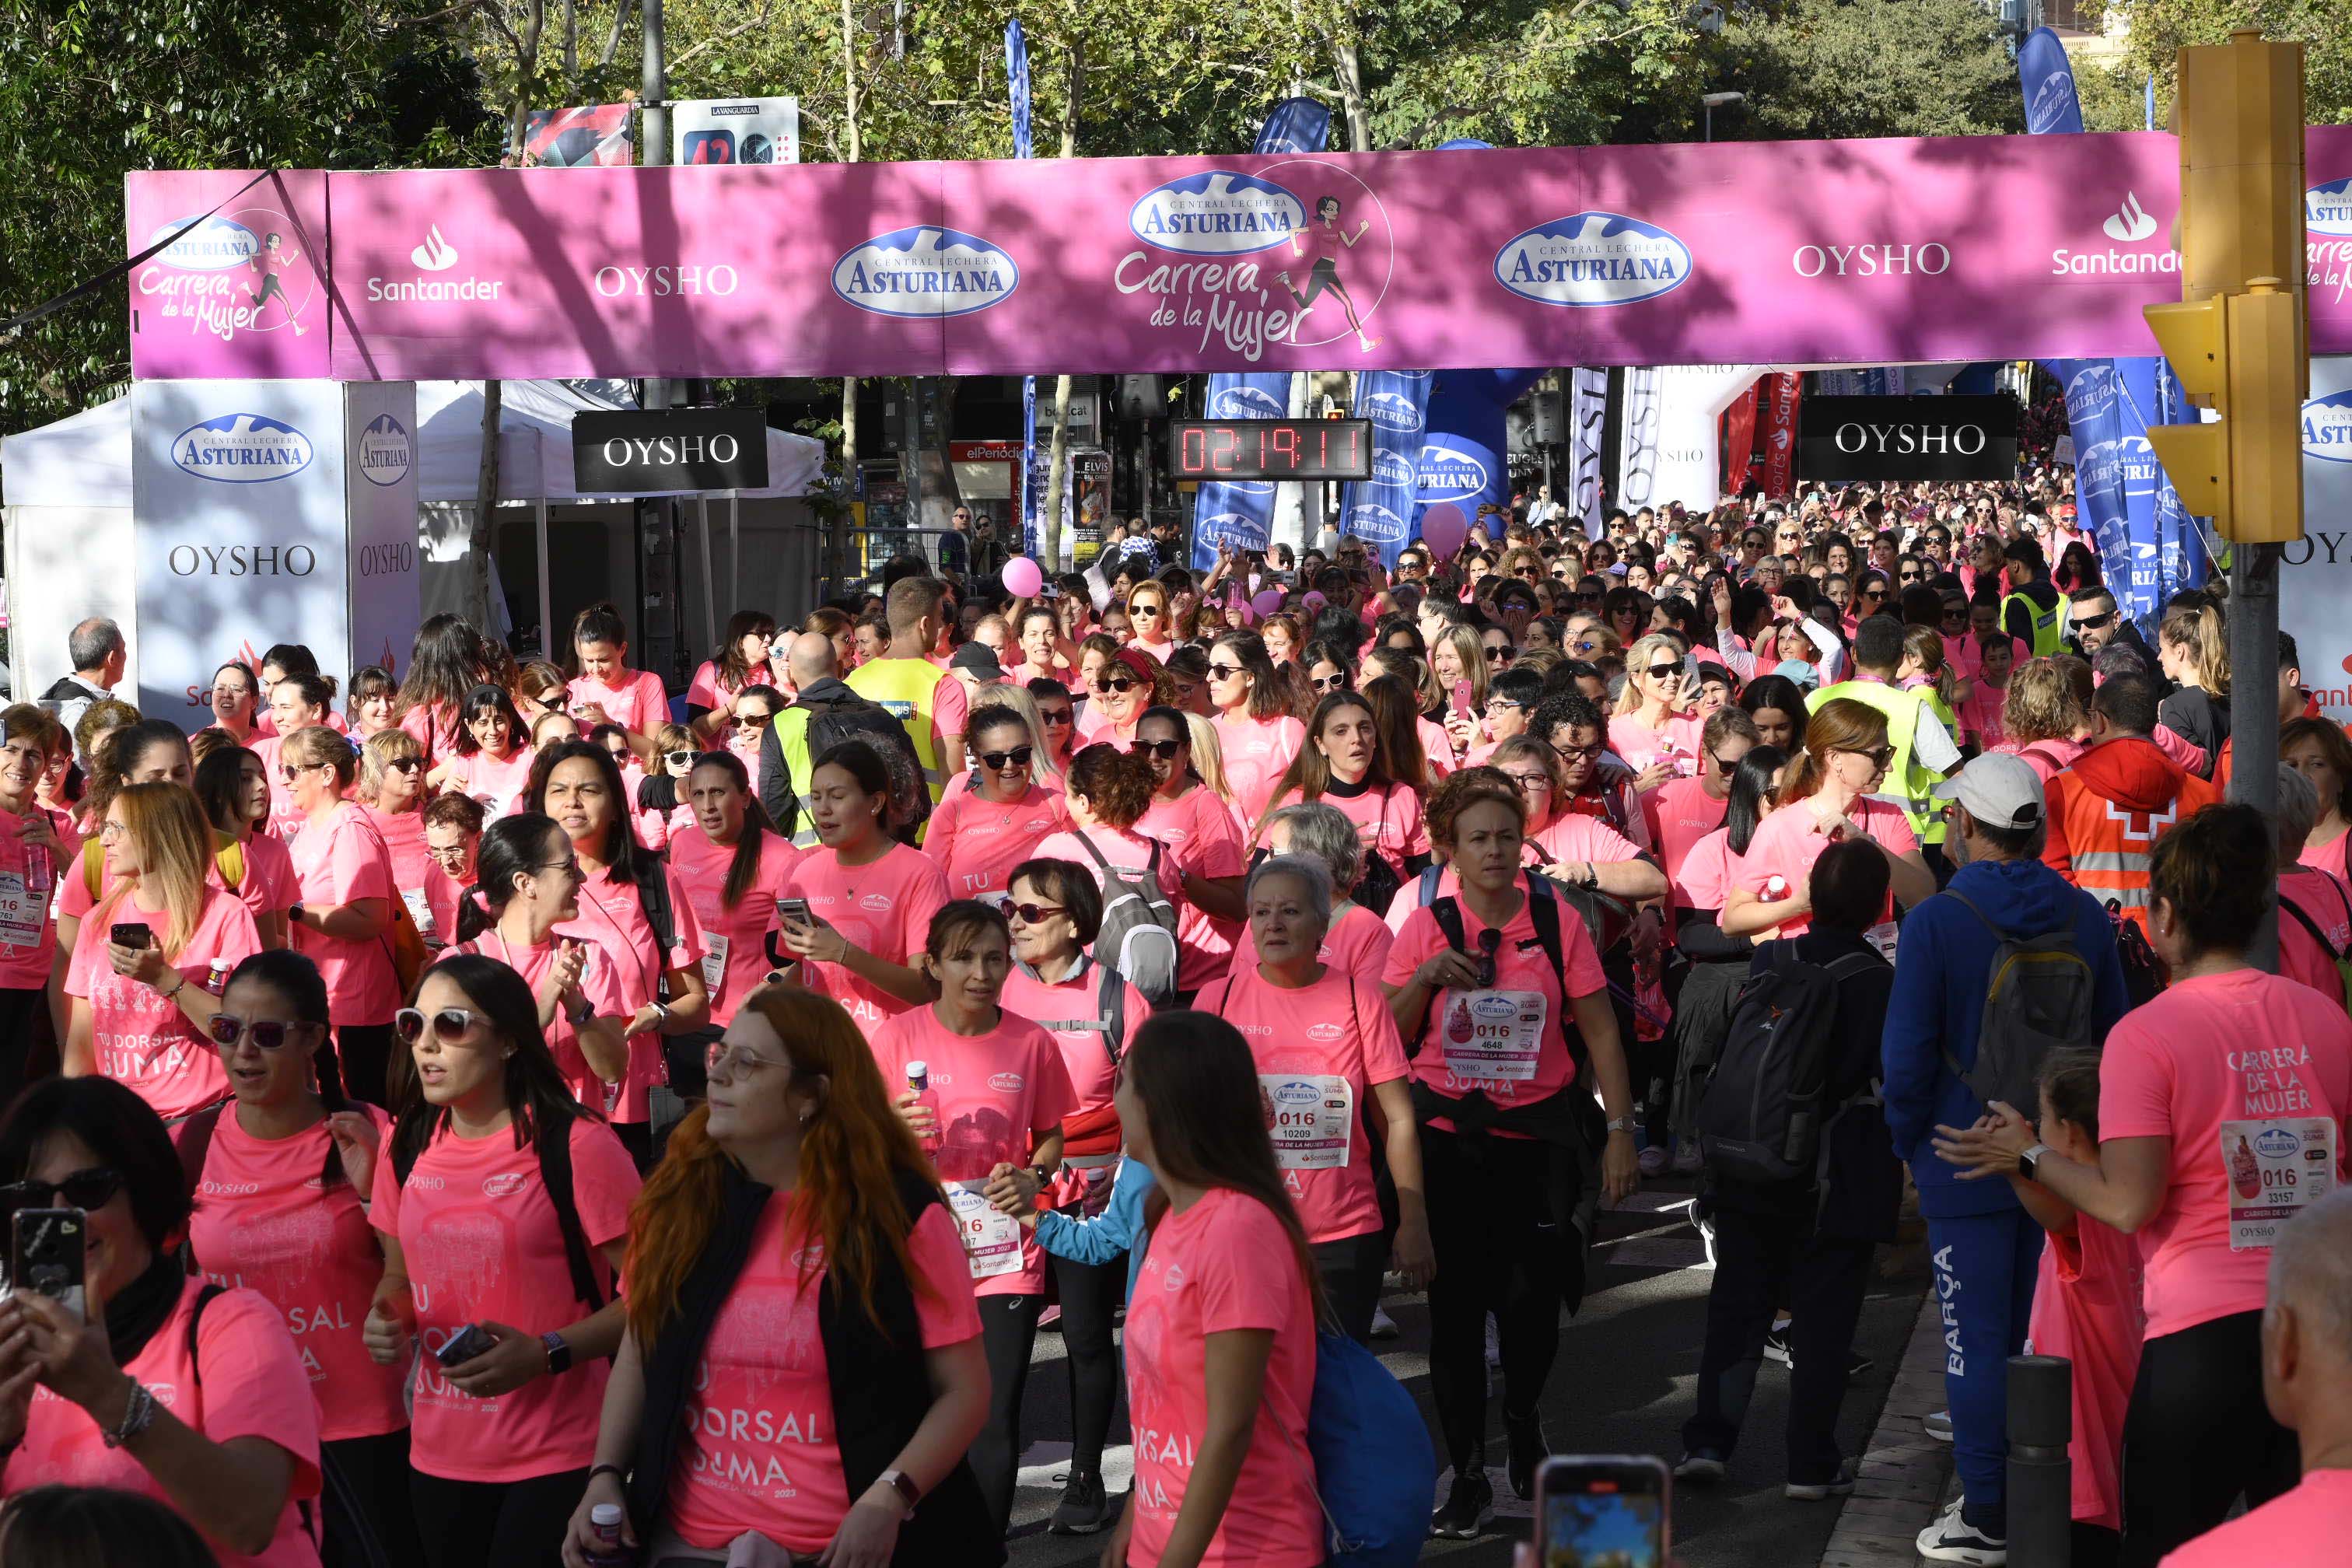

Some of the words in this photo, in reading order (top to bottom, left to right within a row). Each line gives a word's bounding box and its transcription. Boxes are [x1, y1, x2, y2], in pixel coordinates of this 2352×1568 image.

[1169, 200, 1225, 209] CENTRAL
[1231, 198, 1288, 208] LECHERA
[1143, 204, 1293, 234] ASTURIANA
[1540, 244, 1601, 255] CENTRAL
[1607, 243, 1671, 254] LECHERA
[875, 257, 933, 267] CENTRAL
[939, 256, 998, 266] LECHERA
[1508, 248, 1677, 283] ASTURIANA
[1792, 242, 1951, 277] OYSHO
[138, 267, 231, 296] Carrera
[595, 264, 738, 297] OYSHO
[846, 260, 1005, 294] ASTURIANA
[1114, 250, 1260, 295] Carrera
[367, 277, 503, 302] Santander
[161, 298, 178, 317] de
[182, 296, 195, 317] la
[193, 293, 265, 341] Mujer
[1150, 295, 1177, 327] de
[1182, 295, 1202, 327] la
[1198, 290, 1315, 362] Mujer
[1835, 422, 1986, 455] OYSHO
[181, 439, 303, 466] ASTURIANA
[362, 442, 408, 469] ASTURIANA
[604, 434, 739, 467] OYSHO
[1084, 461, 1108, 472] ELVIS
[1772, 453, 1787, 502] ports
[169, 544, 316, 576] OYSHO
[360, 541, 412, 577] OYSHO
[962, 872, 989, 891] TU
[1, 900, 18, 911] 16
[0, 912, 13, 920] 763
[803, 968, 814, 988] U
[1475, 1003, 1514, 1015] ASTURIANA
[97, 1032, 110, 1046] TU
[114, 1030, 184, 1049] DORSAL
[1476, 1024, 1510, 1038] 016
[1481, 1041, 1503, 1050] 4648
[1454, 1063, 1481, 1072] YSHO
[2228, 1044, 2315, 1073] CARRERA
[2246, 1072, 2272, 1094] DE
[2273, 1069, 2303, 1090] LA
[1277, 1090, 1318, 1100] ASTURIANA
[2244, 1090, 2312, 1115] MUJER
[1279, 1112, 1315, 1125] 016
[1283, 1129, 1311, 1139] 10209
[202, 1180, 259, 1194] OYSHO
[2263, 1168, 2297, 1187] 016
[2268, 1191, 2294, 1204] 33157
[962, 1218, 984, 1233] 16
[2240, 1226, 2276, 1237] OYSHO
[974, 1248, 996, 1256] MUJER
[1934, 1244, 1965, 1377] BARÇA
[774, 1488, 796, 1499] 2023
[1138, 1479, 1173, 1508] MA
